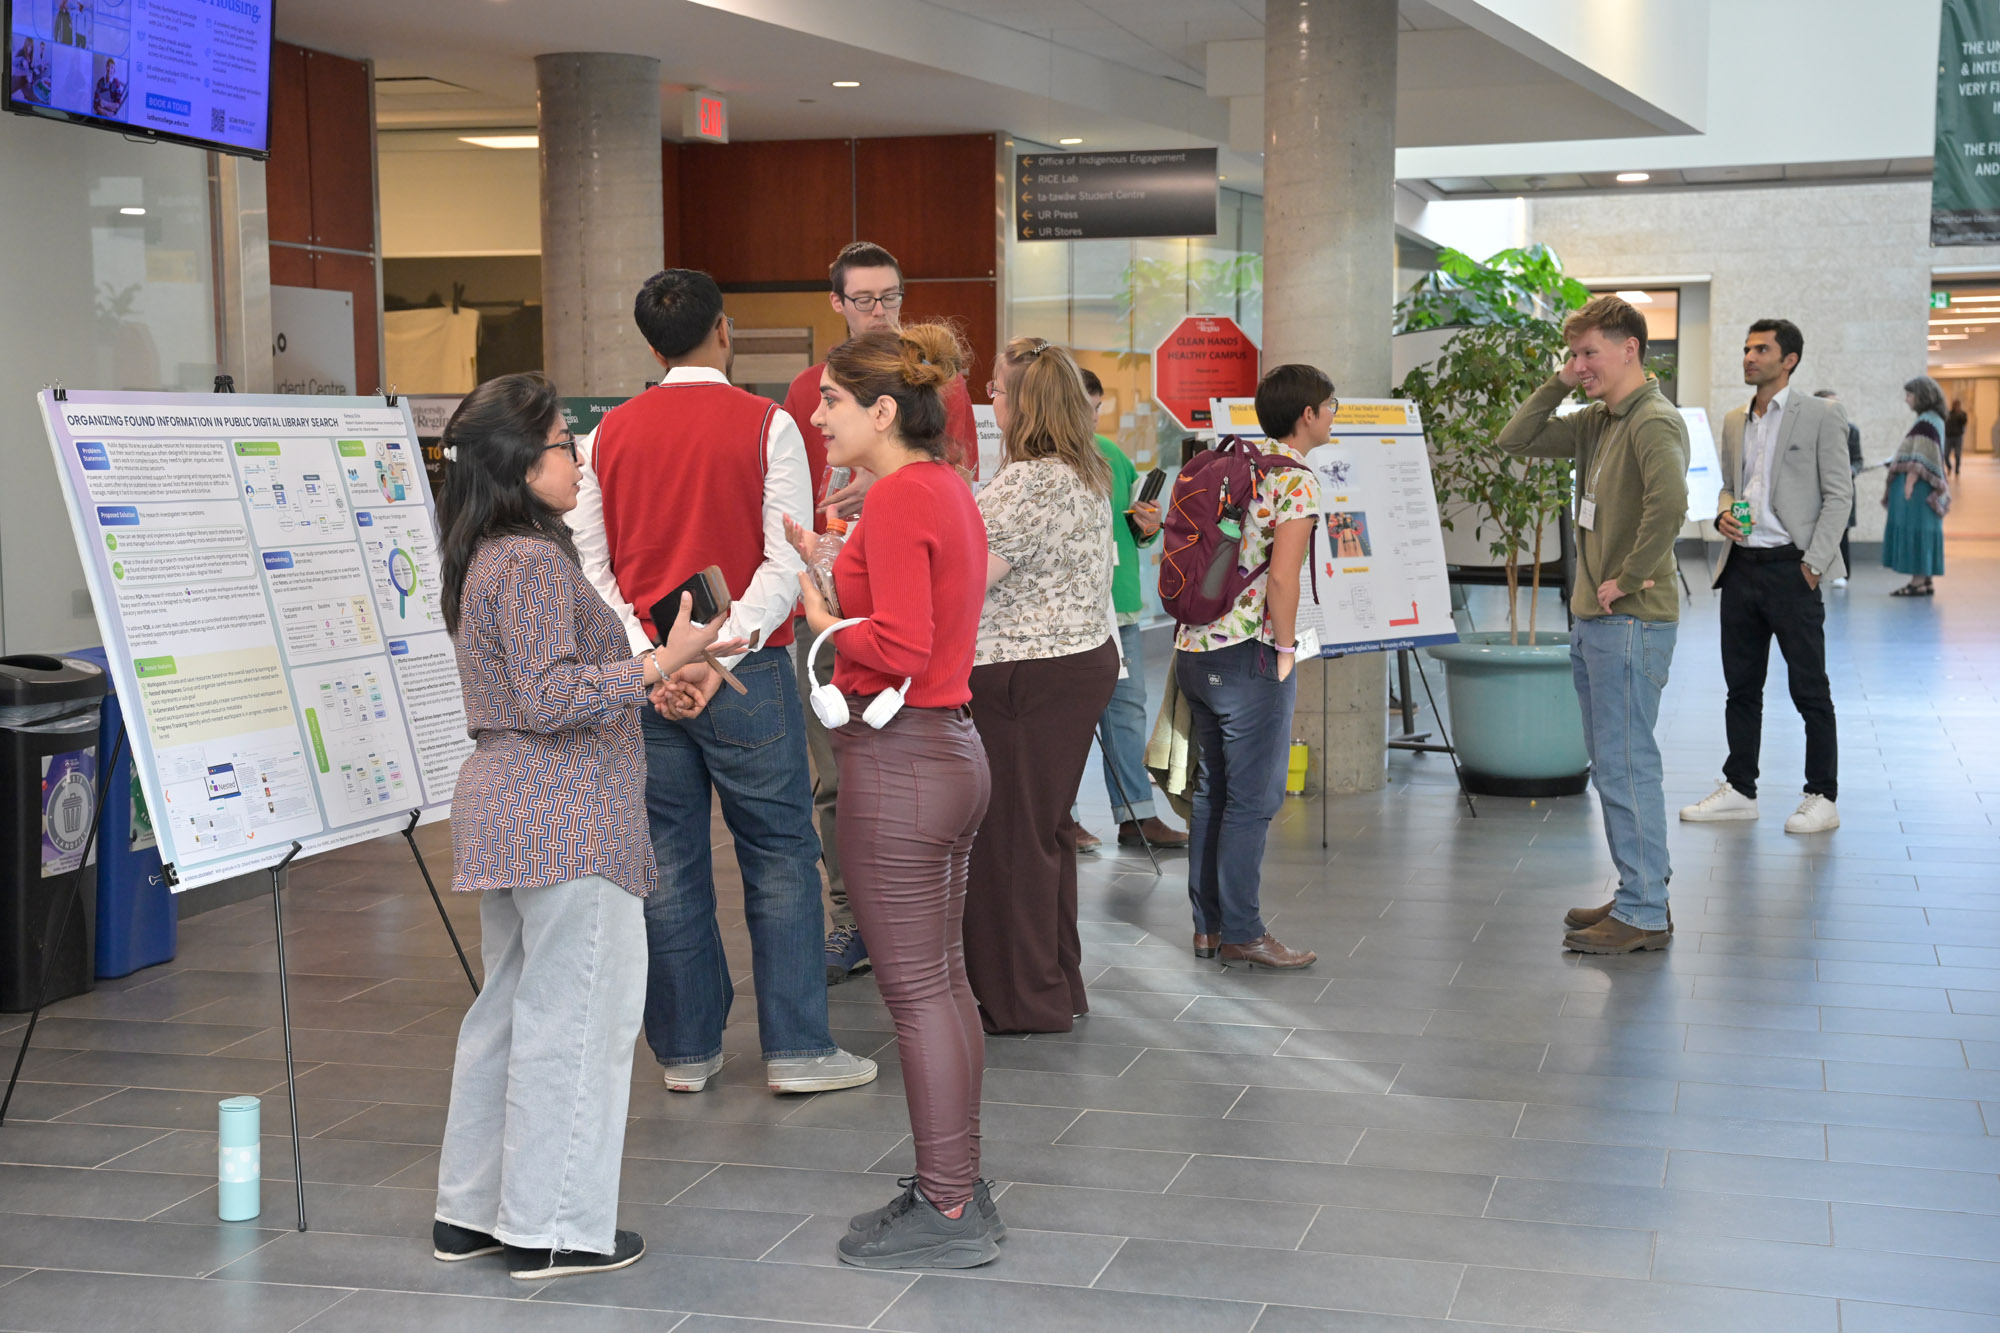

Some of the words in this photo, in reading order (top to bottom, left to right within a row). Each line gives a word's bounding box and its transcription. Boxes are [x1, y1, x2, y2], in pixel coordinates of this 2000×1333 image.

[1962, 41, 1984, 55] THE
[1986, 40, 2000, 54] UN
[1960, 62, 1970, 76] &
[1972, 61, 2000, 74] INTE
[1958, 82, 1987, 96] VERY
[1990, 80, 2000, 94] FI
[149, 97, 166, 108] BOOK
[166, 101, 172, 110] A
[172, 102, 189, 112] TOUR
[1963, 143, 1986, 156] THE
[1988, 142, 2000, 155] FI
[1038, 157, 1064, 166] Office
[1065, 156, 1075, 165] of
[1079, 155, 1127, 166] Indigenous
[1130, 154, 1186, 166] Engagement
[1038, 175, 1059, 184] RICE
[1062, 174, 1078, 184] Lab
[1078, 191, 1113, 200] Student
[1116, 190, 1145, 200] Centre
[1038, 210, 1052, 220] UR
[1054, 210, 1078, 219] Press
[1039, 228, 1052, 236] UR
[1054, 227, 1083, 236] Stores
[1177, 337, 1205, 346] CLEAN
[1208, 337, 1238, 345] HANDS
[1168, 352, 1206, 360] HEALTHY
[1209, 351, 1247, 360] CAMPUS
[590, 404, 600, 412] Jets
[67, 416, 123, 426] ORGANIZING
[124, 416, 155, 426] FOUND
[156, 416, 213, 427] INFORMATION
[214, 417, 223, 427] IN
[225, 417, 251, 427] PUBLIC
[252, 417, 281, 427] DIGITAL
[281, 418, 310, 427] LIBRARY
[311, 418, 339, 427] SEARCH
[416, 415, 450, 430] Regin
[976, 420, 995, 429] deoffs:
[980, 432, 1002, 440] Sasma
[428, 447, 442, 460] TO
[1733, 505, 1750, 518] Spr
[218, 781, 236, 791] Nested
